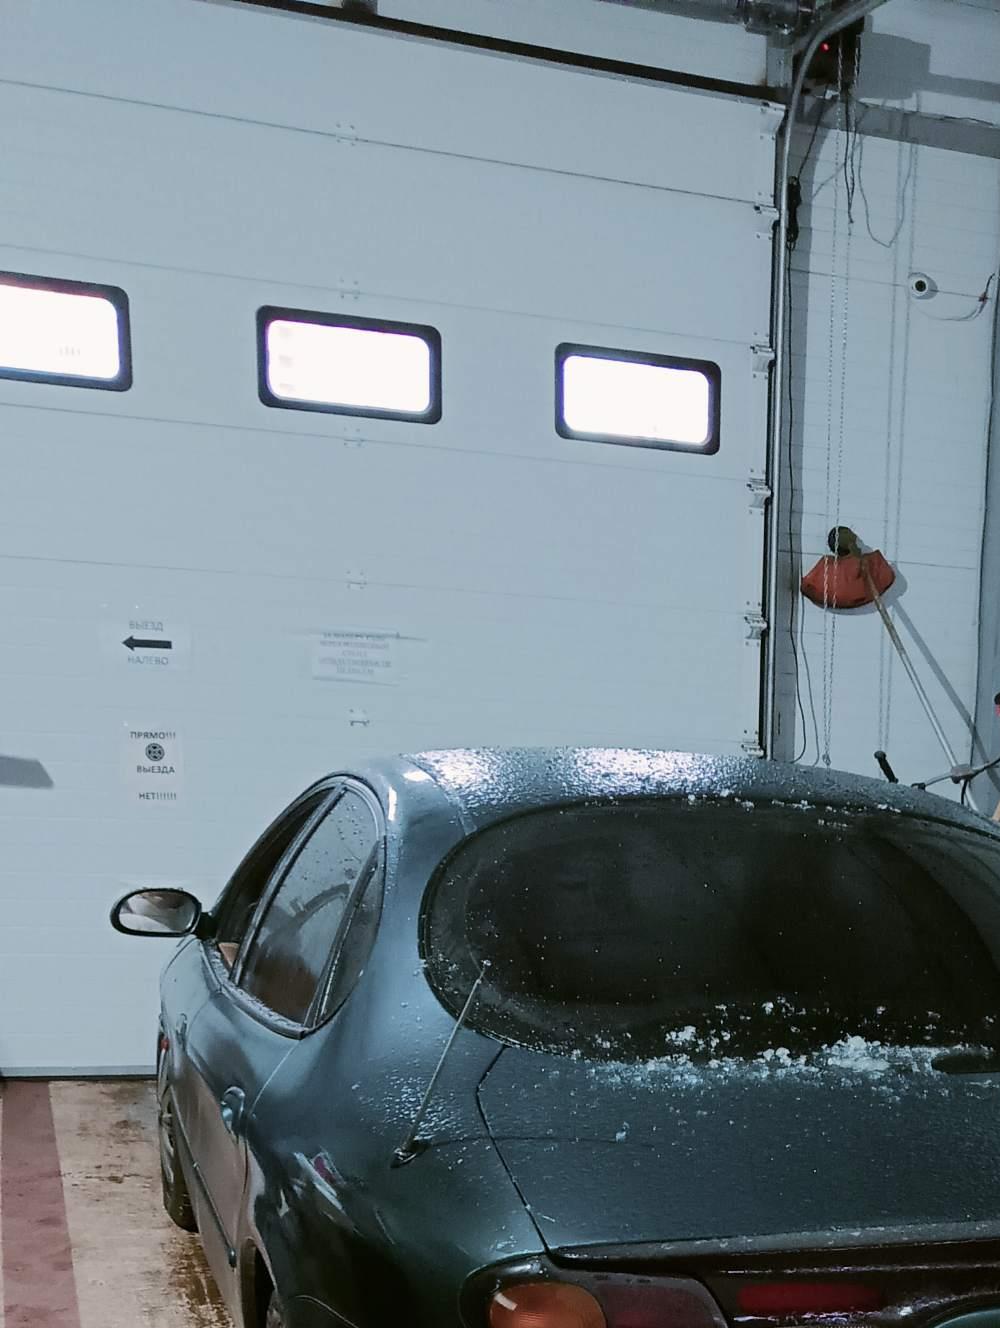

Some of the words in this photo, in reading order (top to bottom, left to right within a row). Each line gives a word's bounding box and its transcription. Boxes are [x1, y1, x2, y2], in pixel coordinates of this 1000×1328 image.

[128, 620, 164, 632] ВЫЕЗД
[127, 656, 169, 666] НАЛЕВО
[136, 765, 175, 775] ВЫЕЗДА
